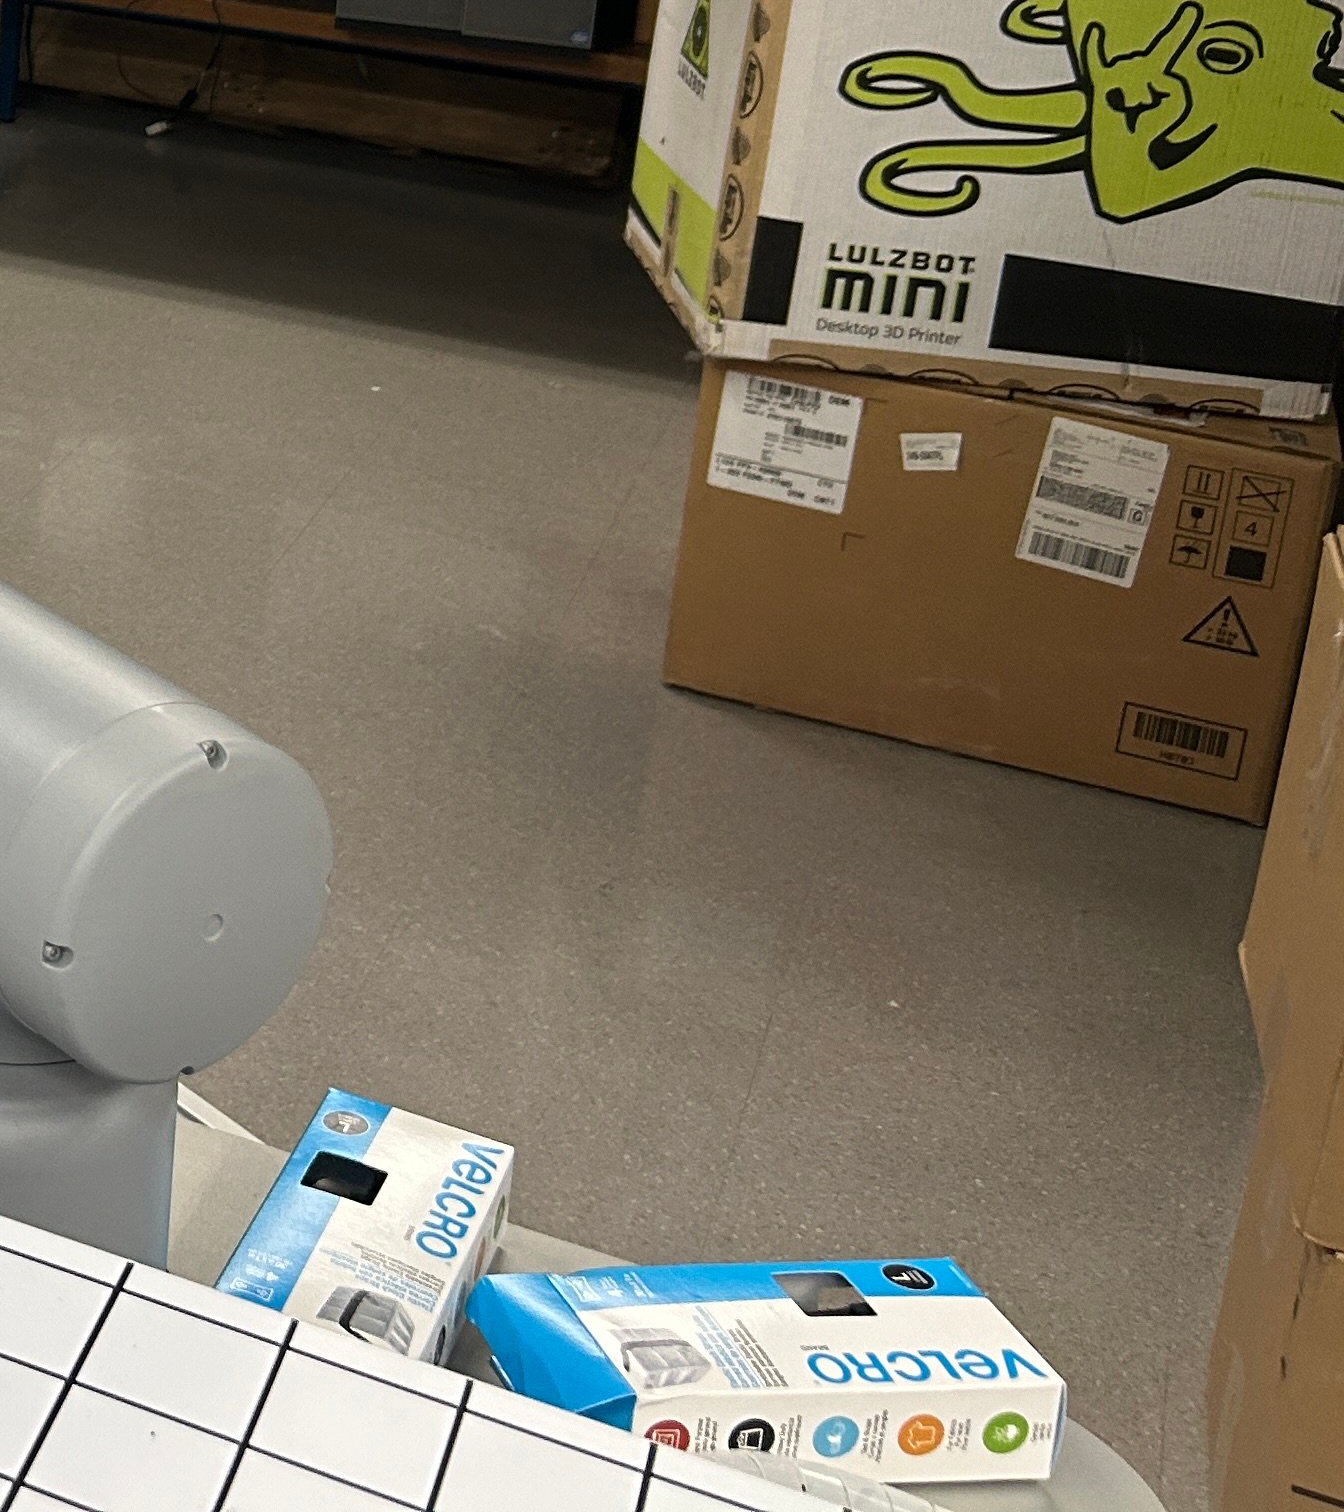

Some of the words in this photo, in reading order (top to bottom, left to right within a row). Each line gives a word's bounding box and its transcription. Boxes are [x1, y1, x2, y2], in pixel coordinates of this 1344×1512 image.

[828, 242, 976, 275] LULZBOT
[815, 317, 879, 339] Desktop
[883, 324, 904, 338] 3D
[908, 326, 962, 345] Printer
[1244, 521, 1258, 537] 4
